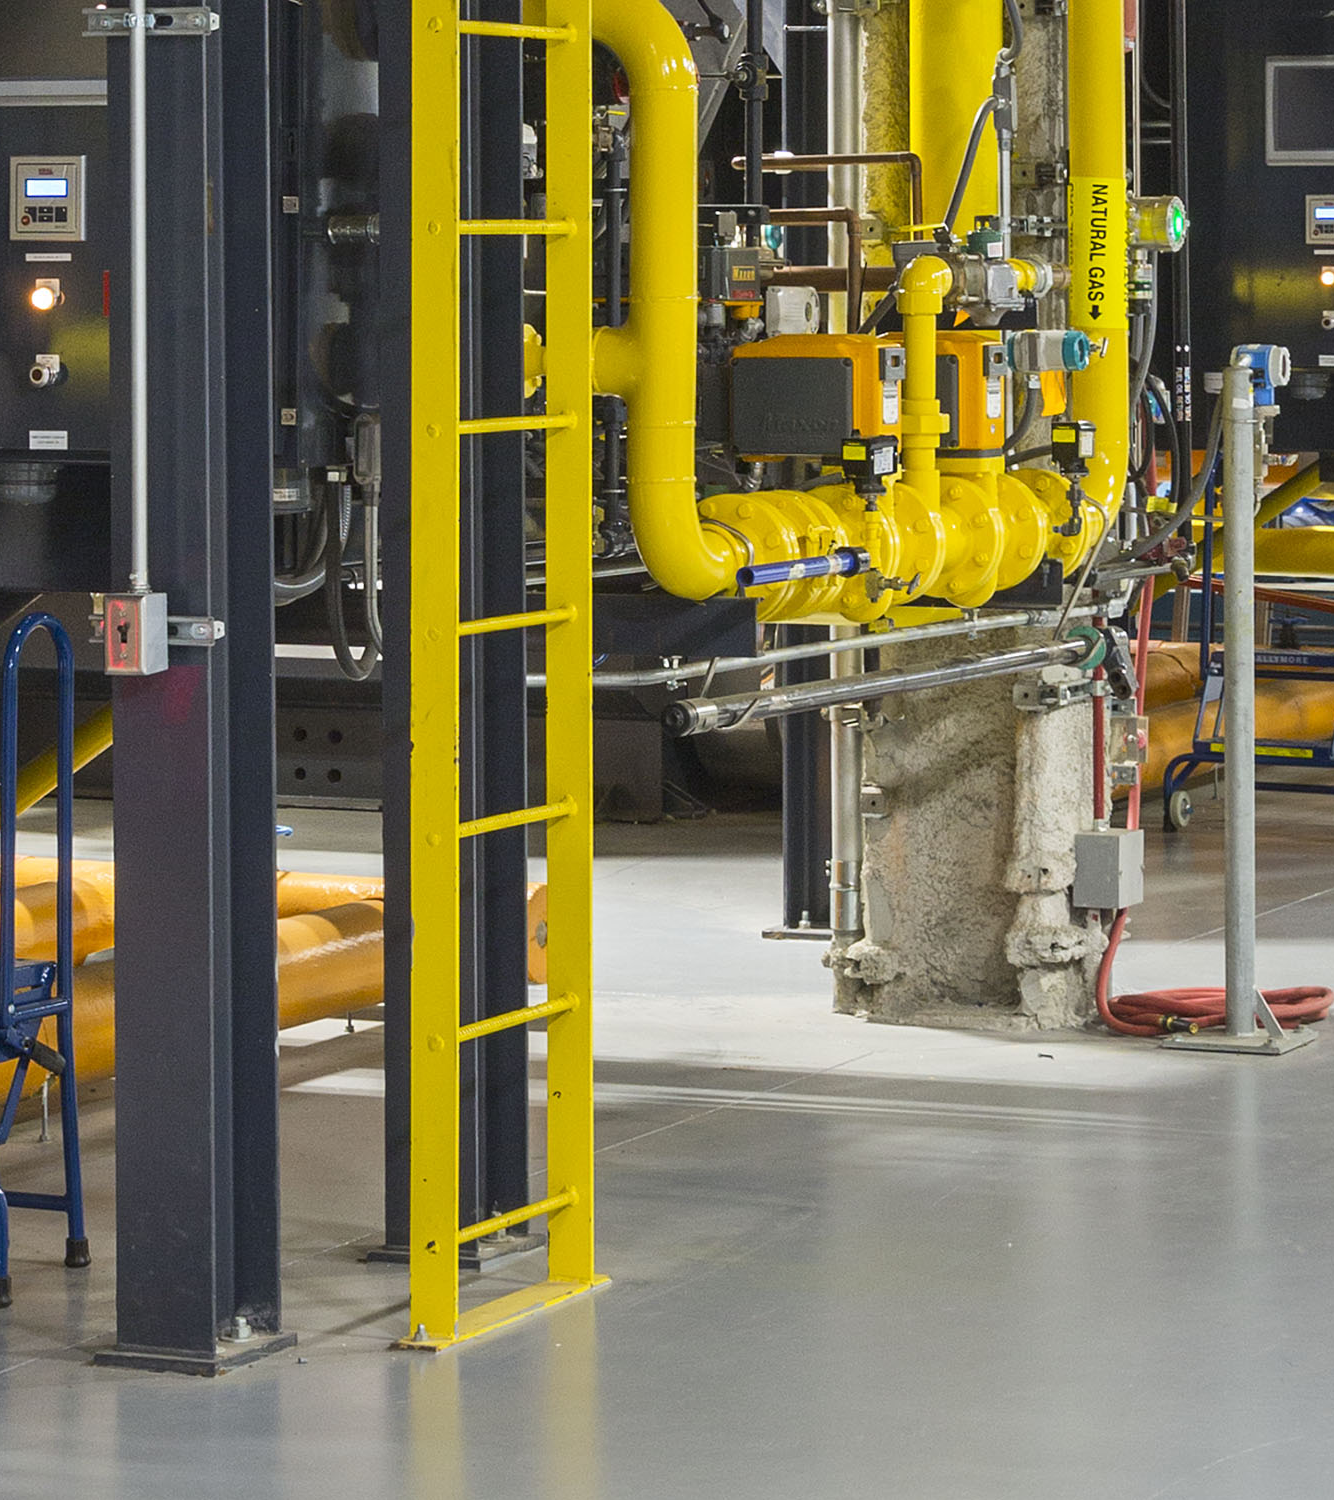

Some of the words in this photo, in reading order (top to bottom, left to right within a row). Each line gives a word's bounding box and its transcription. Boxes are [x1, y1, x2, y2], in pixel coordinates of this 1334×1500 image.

[1089, 183, 1109, 264] NATURAL
[1087, 266, 1106, 303] GAS
[1254, 655, 1308, 665] ALLYMORE
